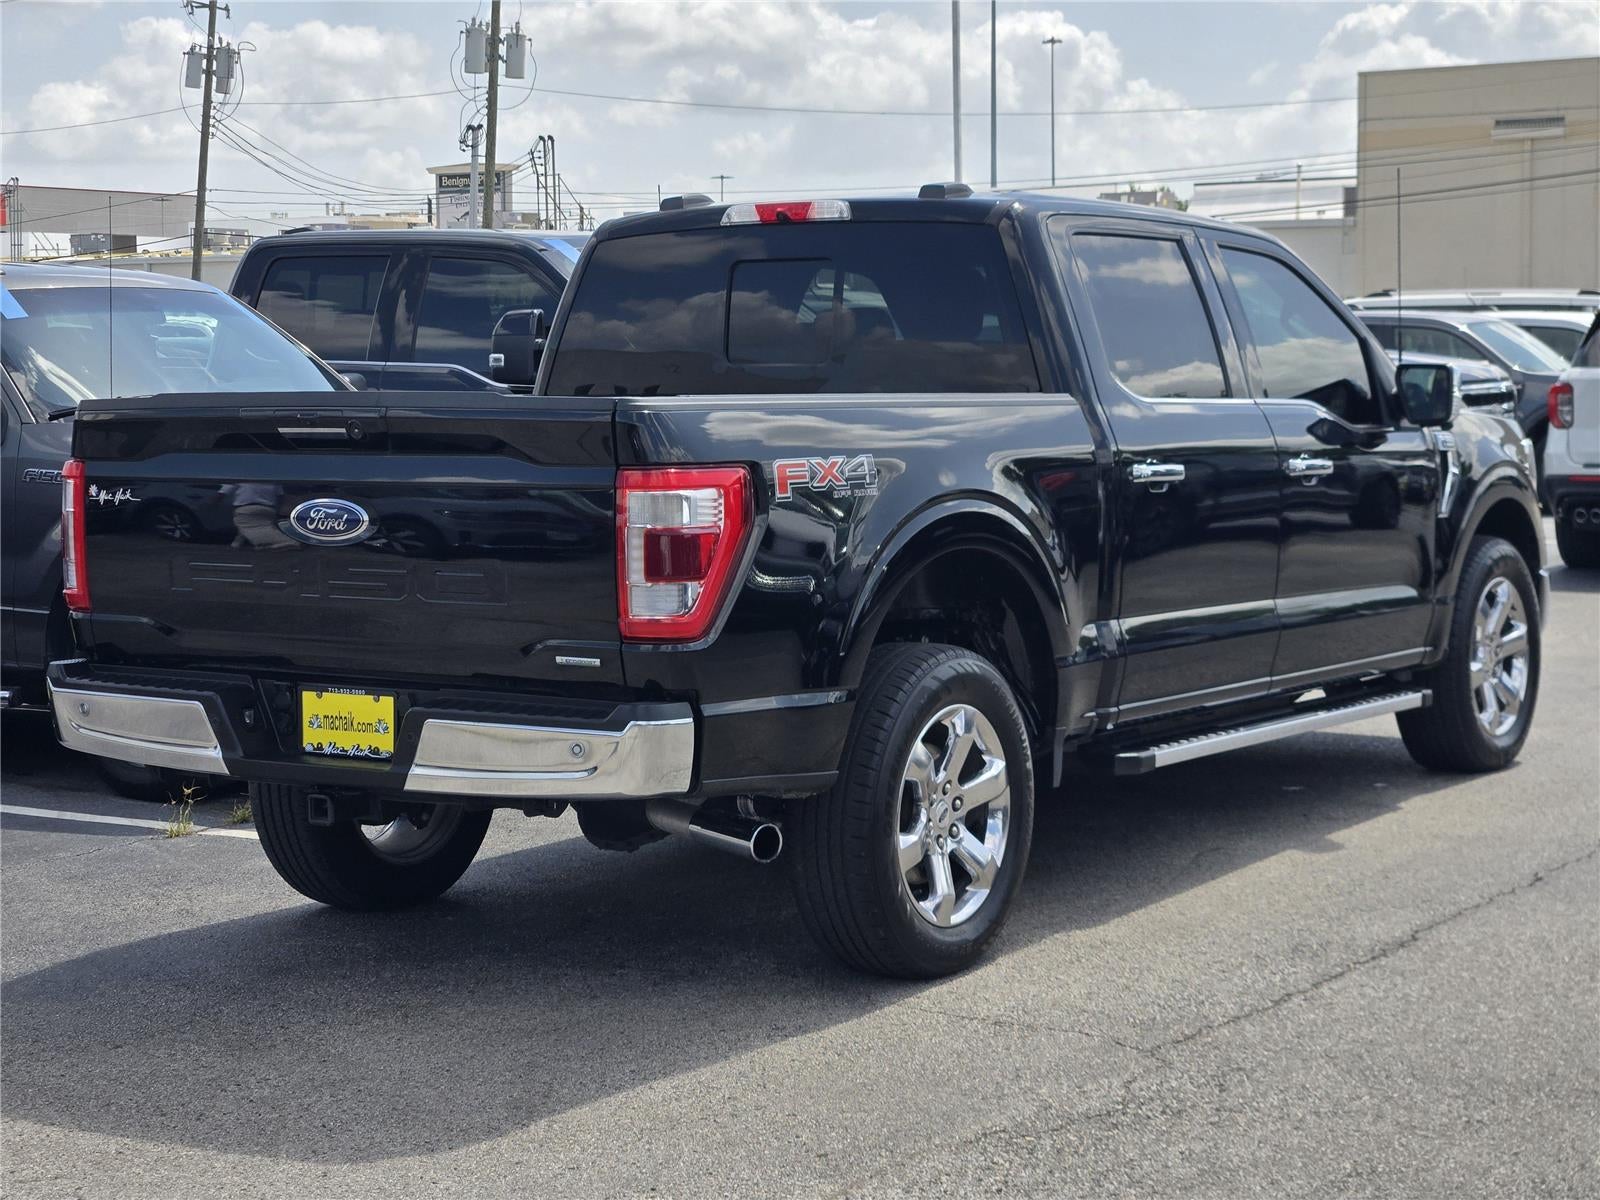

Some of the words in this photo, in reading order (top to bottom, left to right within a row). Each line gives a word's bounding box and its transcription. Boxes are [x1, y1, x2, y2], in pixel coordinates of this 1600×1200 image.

[773, 454, 879, 502] FX4
[306, 507, 348, 531] Ford
[322, 711, 374, 734] machaik.com
